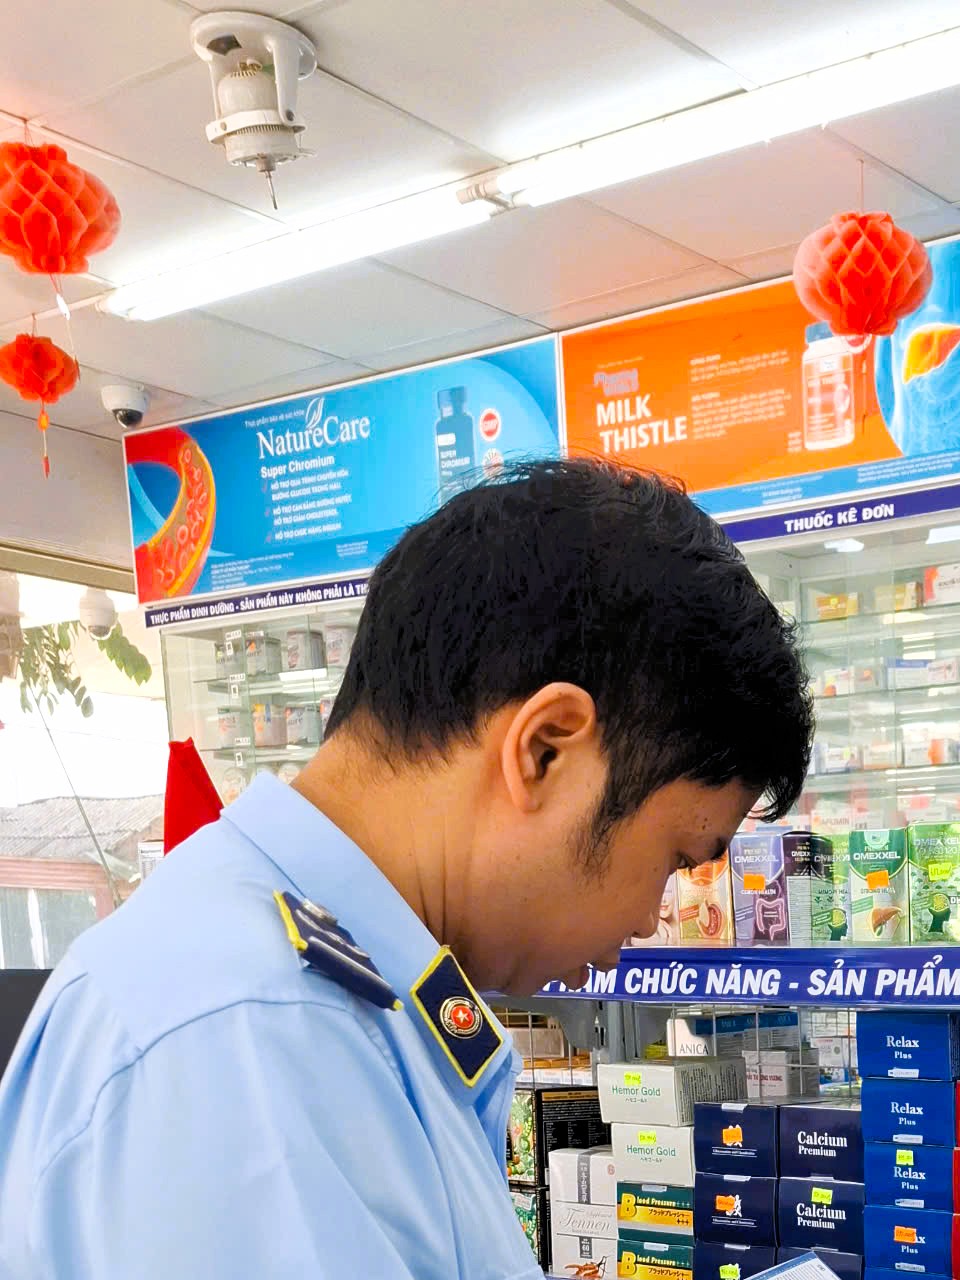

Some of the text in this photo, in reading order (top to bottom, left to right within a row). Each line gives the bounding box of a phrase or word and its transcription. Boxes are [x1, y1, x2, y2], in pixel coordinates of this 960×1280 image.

[596, 394, 652, 427] MILK
[256, 415, 370, 459] NatureCare
[600, 416, 688, 453] THISTLE
[260, 455, 335, 479] Super Chromium
[785, 503, 895, 533] THUỐC KÊ ĐƠN
[295, 588, 322, 603] KHÔNG
[624, 961, 697, 994] CHỨC
[705, 963, 781, 995] NĂNG
[807, 959, 866, 995] SẢN
[886, 1035, 919, 1048] Relax
[894, 1051, 912, 1059] Plus
[611, 1085, 661, 1097] Hemor Gold
[890, 1102, 923, 1115] Relax
[897, 1117, 916, 1126] Plus
[797, 1131, 848, 1149] Calcium
[626, 1145, 676, 1157] Hemor Gold
[798, 1145, 836, 1158] Premium
[893, 1166, 926, 1180] Relax
[796, 1202, 846, 1221] Calcium
[797, 1217, 835, 1230] Premium
